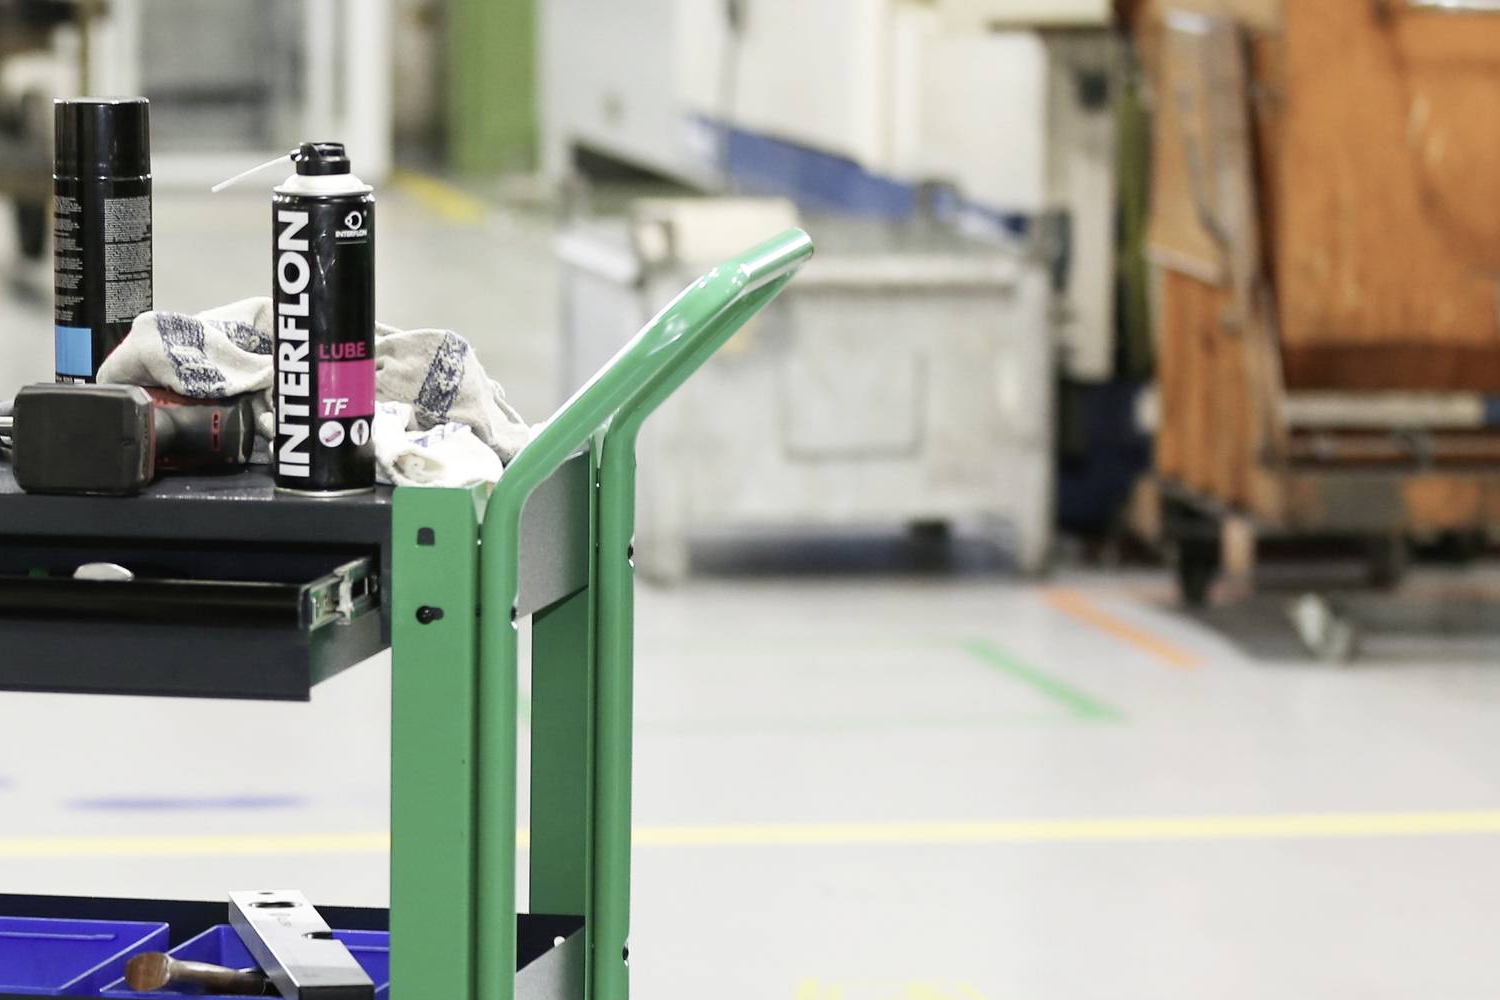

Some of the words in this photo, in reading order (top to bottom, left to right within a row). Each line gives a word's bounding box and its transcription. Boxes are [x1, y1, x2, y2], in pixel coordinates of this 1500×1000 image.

[277, 210, 310, 477] INTERFLON
[318, 341, 366, 360] LUBE
[322, 398, 349, 416] TF
